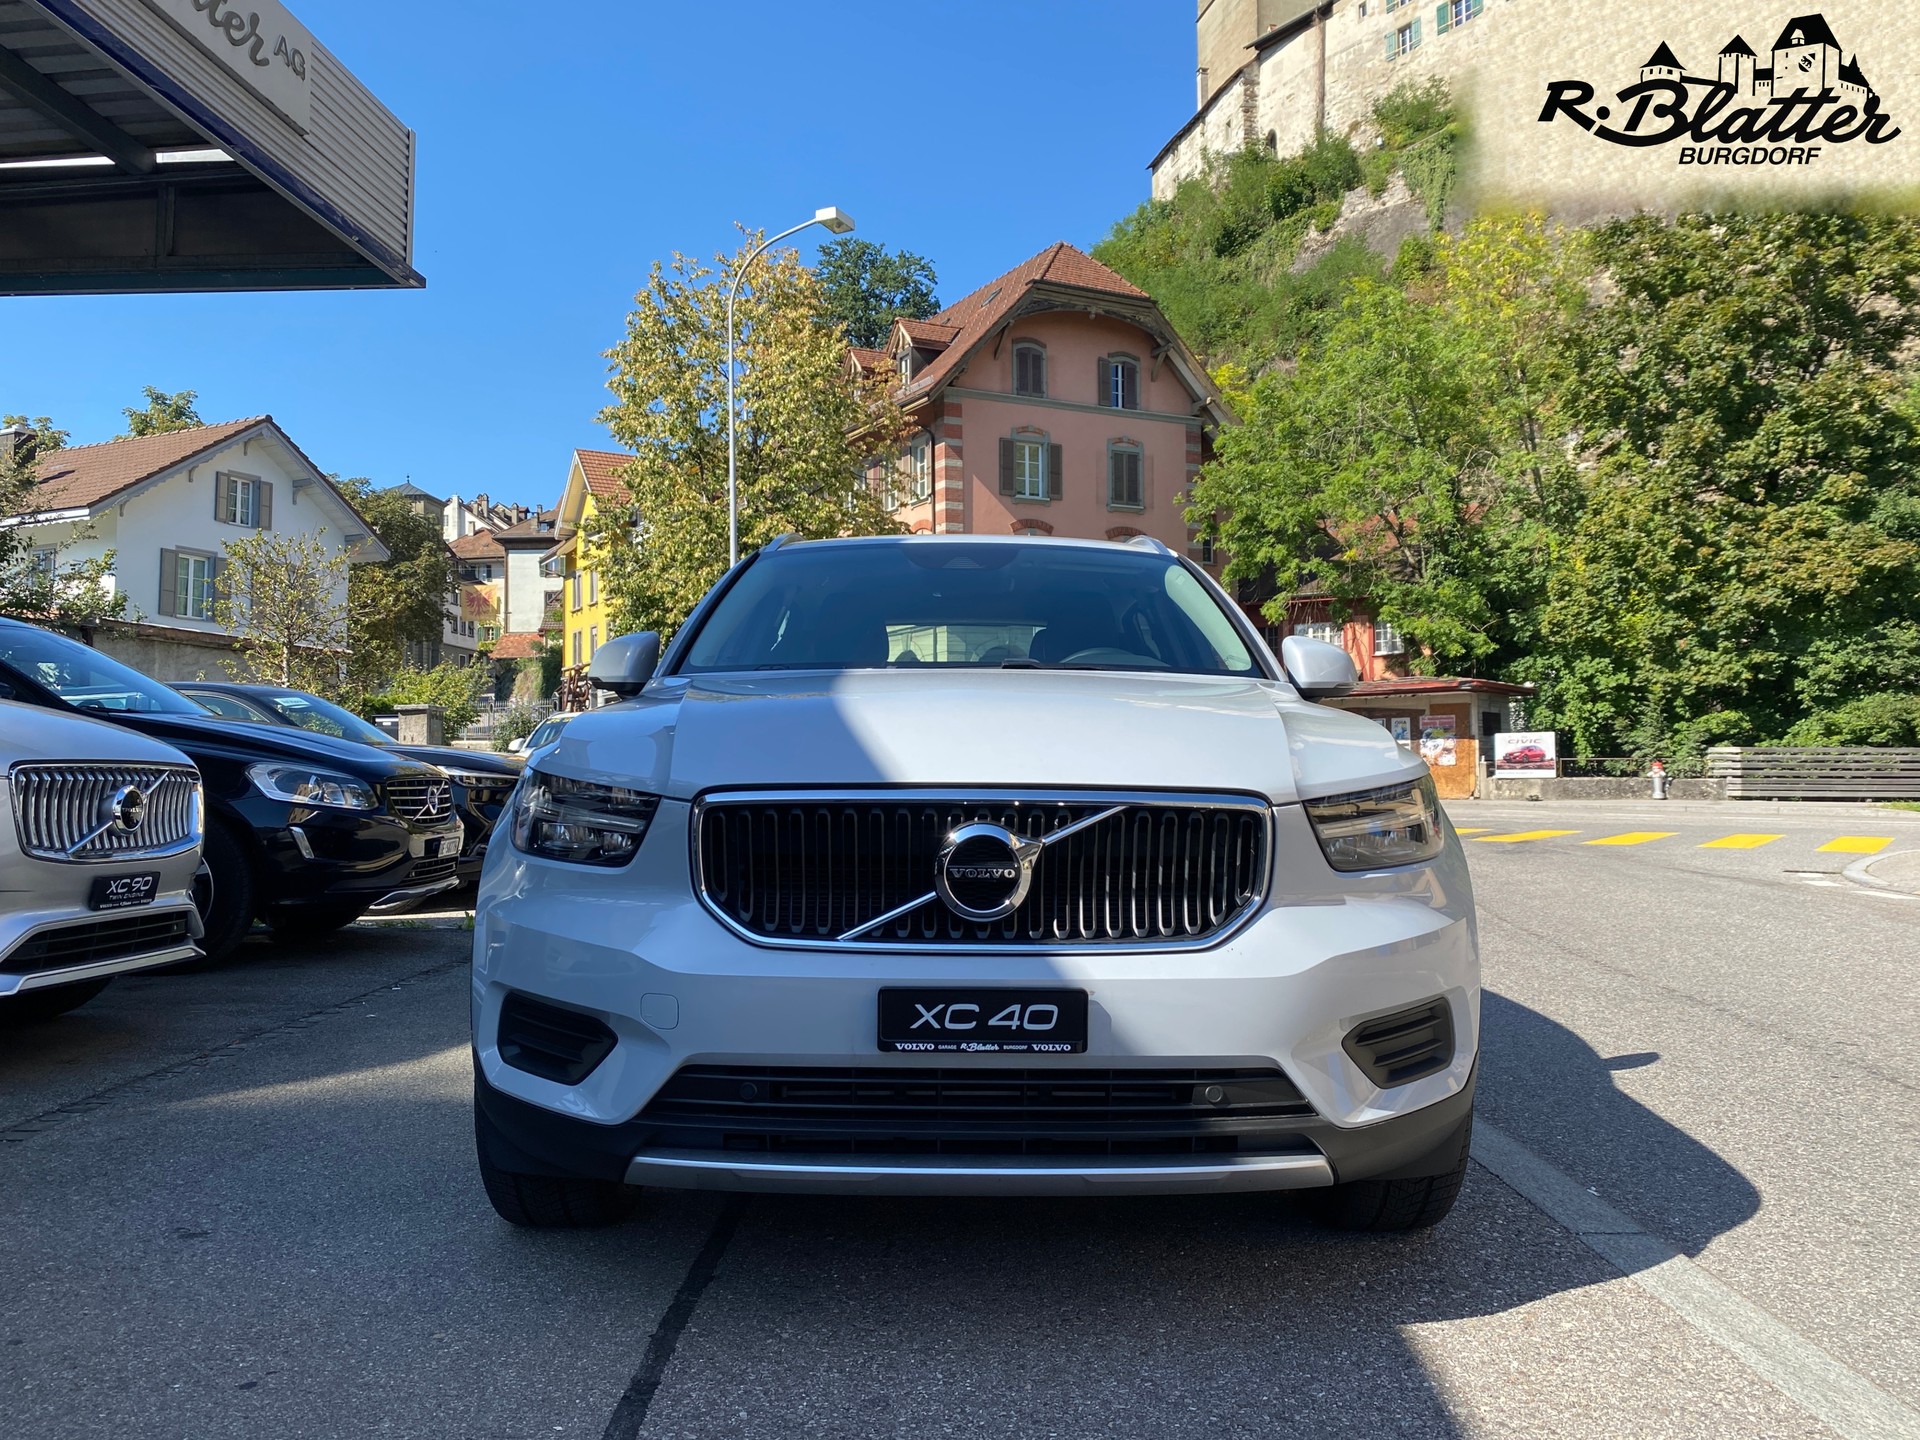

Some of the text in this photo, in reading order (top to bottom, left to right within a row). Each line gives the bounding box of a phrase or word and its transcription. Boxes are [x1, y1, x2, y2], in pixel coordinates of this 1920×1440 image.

[273, 34, 306, 81] AG
[949, 868, 1016, 878] VOLVO
[106, 876, 153, 894] XC 90
[909, 1003, 1059, 1031] XC 40
[894, 1042, 935, 1051] VOLVO
[1031, 1043, 1072, 1051] VOLVO
